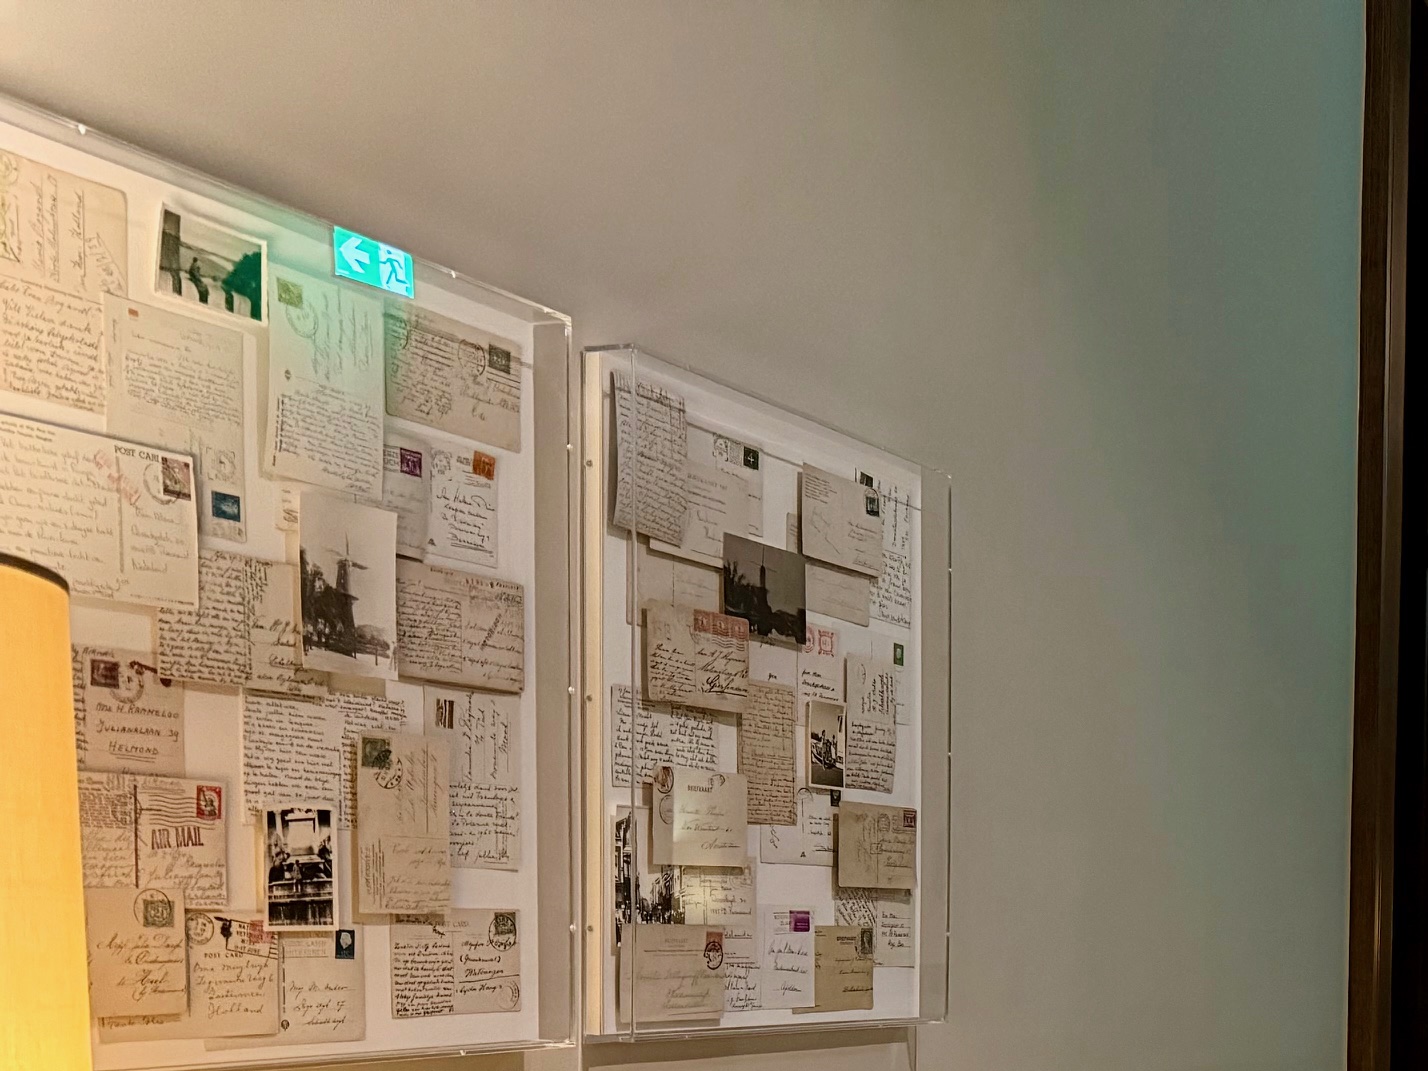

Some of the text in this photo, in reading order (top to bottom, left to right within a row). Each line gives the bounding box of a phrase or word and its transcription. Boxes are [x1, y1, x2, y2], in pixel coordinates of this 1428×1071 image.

[114, 444, 136, 457] POST
[108, 740, 159, 756] HELMOND
[151, 826, 204, 850] AIR MAIL
